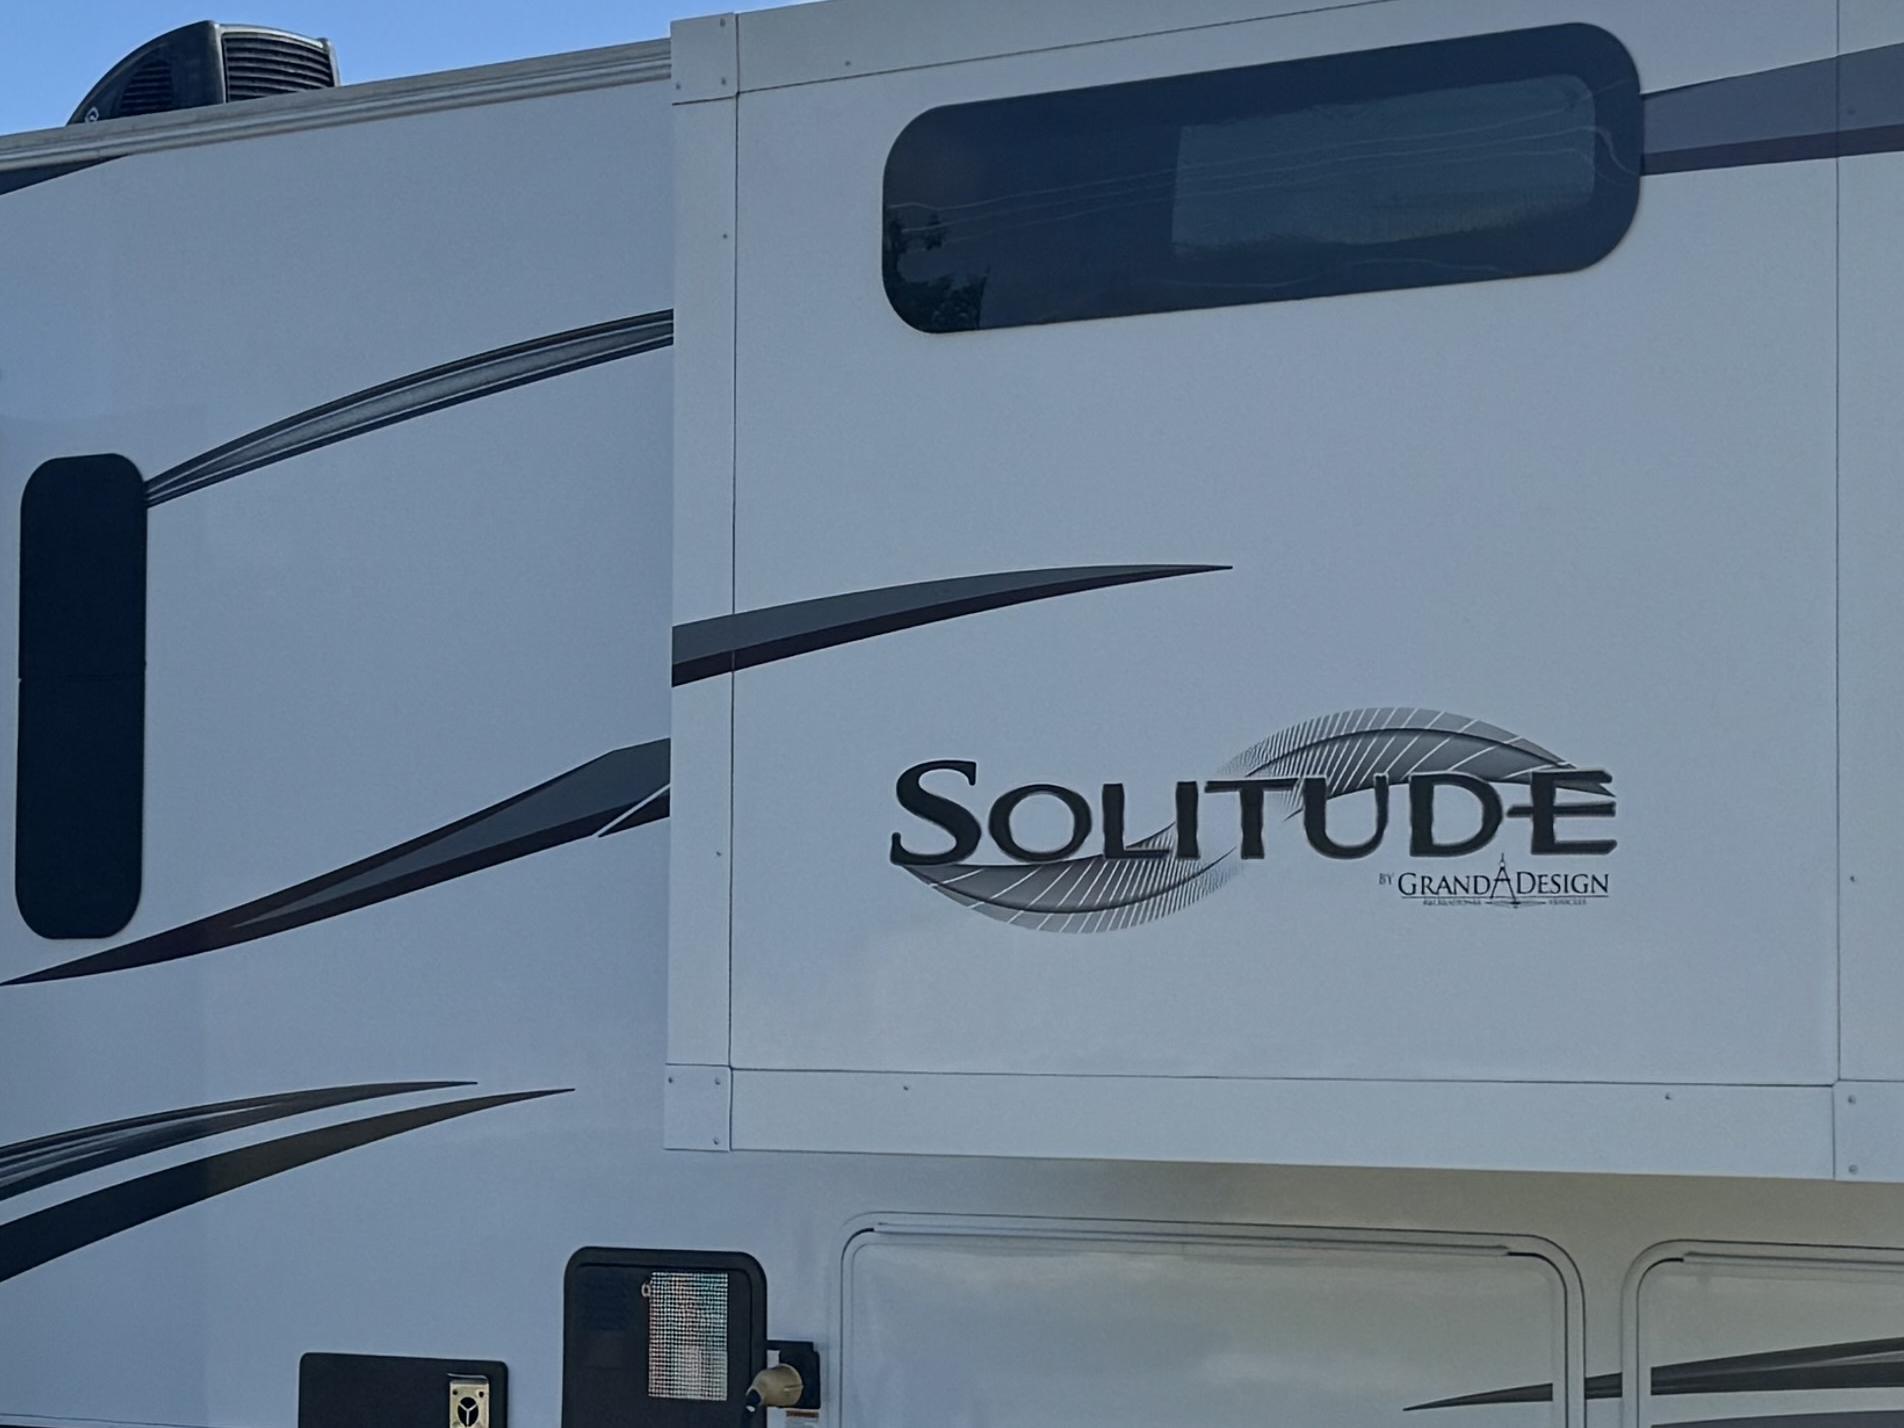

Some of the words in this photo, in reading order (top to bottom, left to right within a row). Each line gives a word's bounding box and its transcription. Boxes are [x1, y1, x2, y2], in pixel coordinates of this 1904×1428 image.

[889, 758, 1619, 866] SOLITUDE
[1379, 873, 1394, 885] BY
[1398, 872, 1491, 896] GRAND
[1516, 871, 1610, 895] DESIGN
